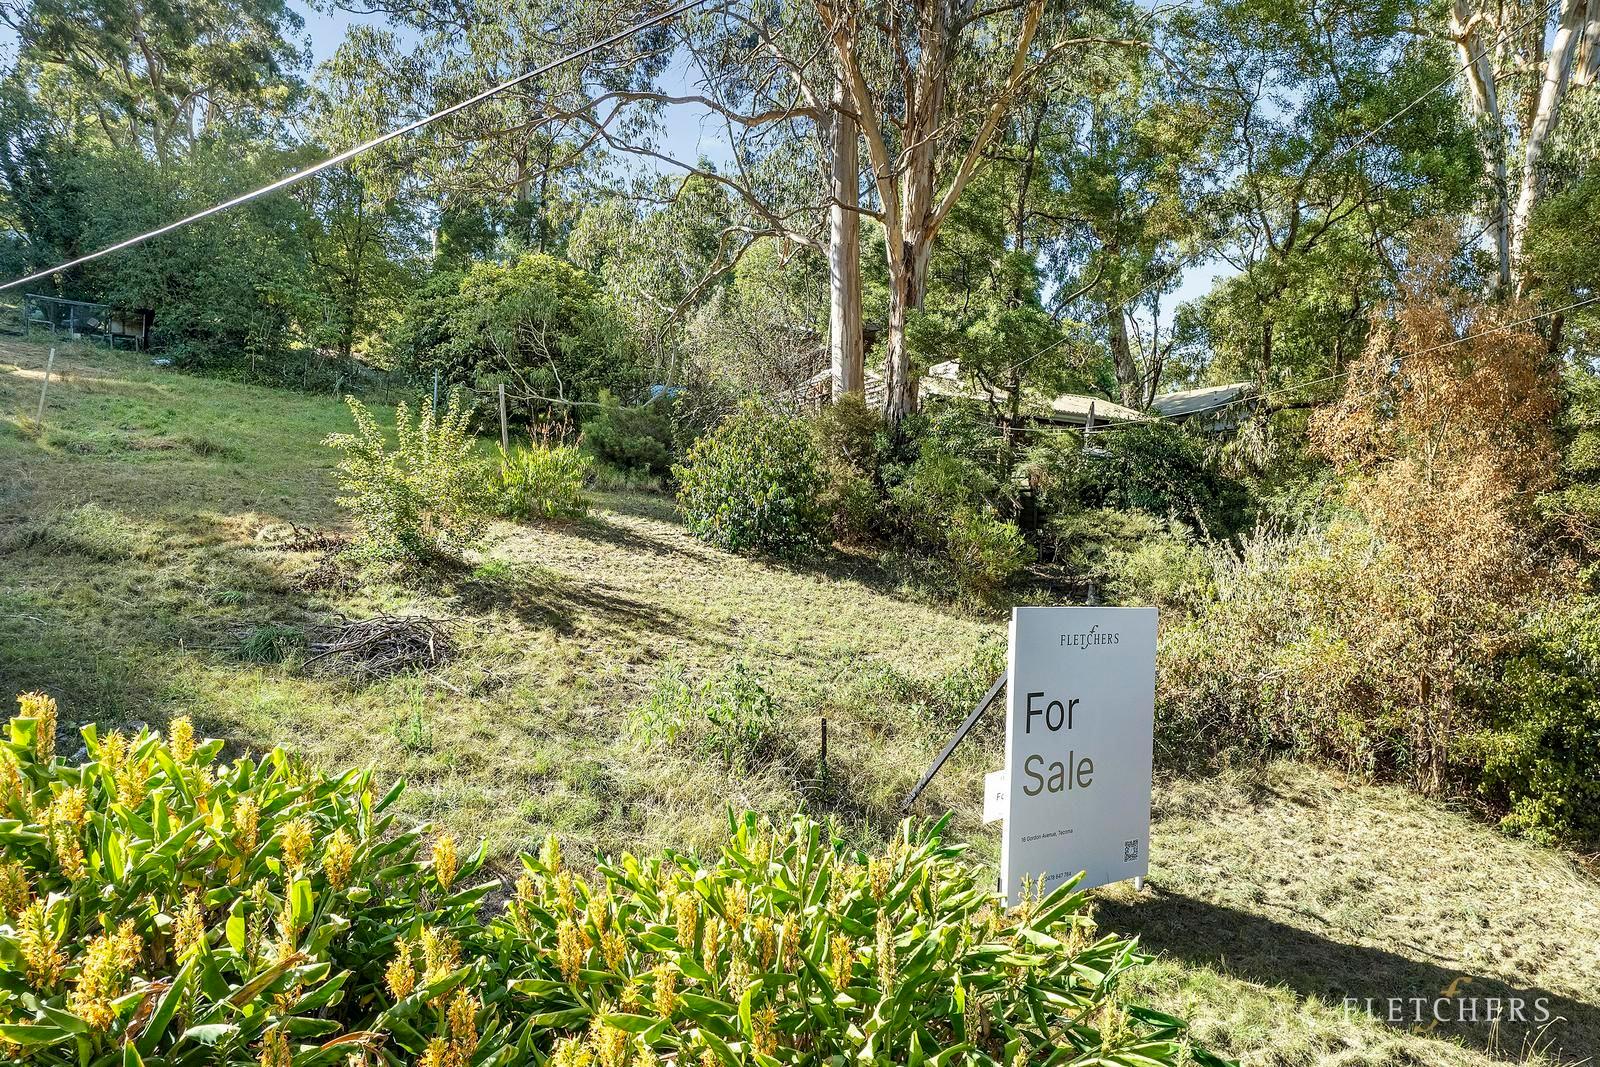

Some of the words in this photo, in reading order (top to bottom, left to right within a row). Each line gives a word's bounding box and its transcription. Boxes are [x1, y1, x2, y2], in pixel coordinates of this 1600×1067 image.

[1060, 631, 1120, 647] FLETCHERS
[1025, 691, 1080, 734] For
[1023, 750, 1094, 797] Sale
[1026, 834, 1041, 842] Gordon
